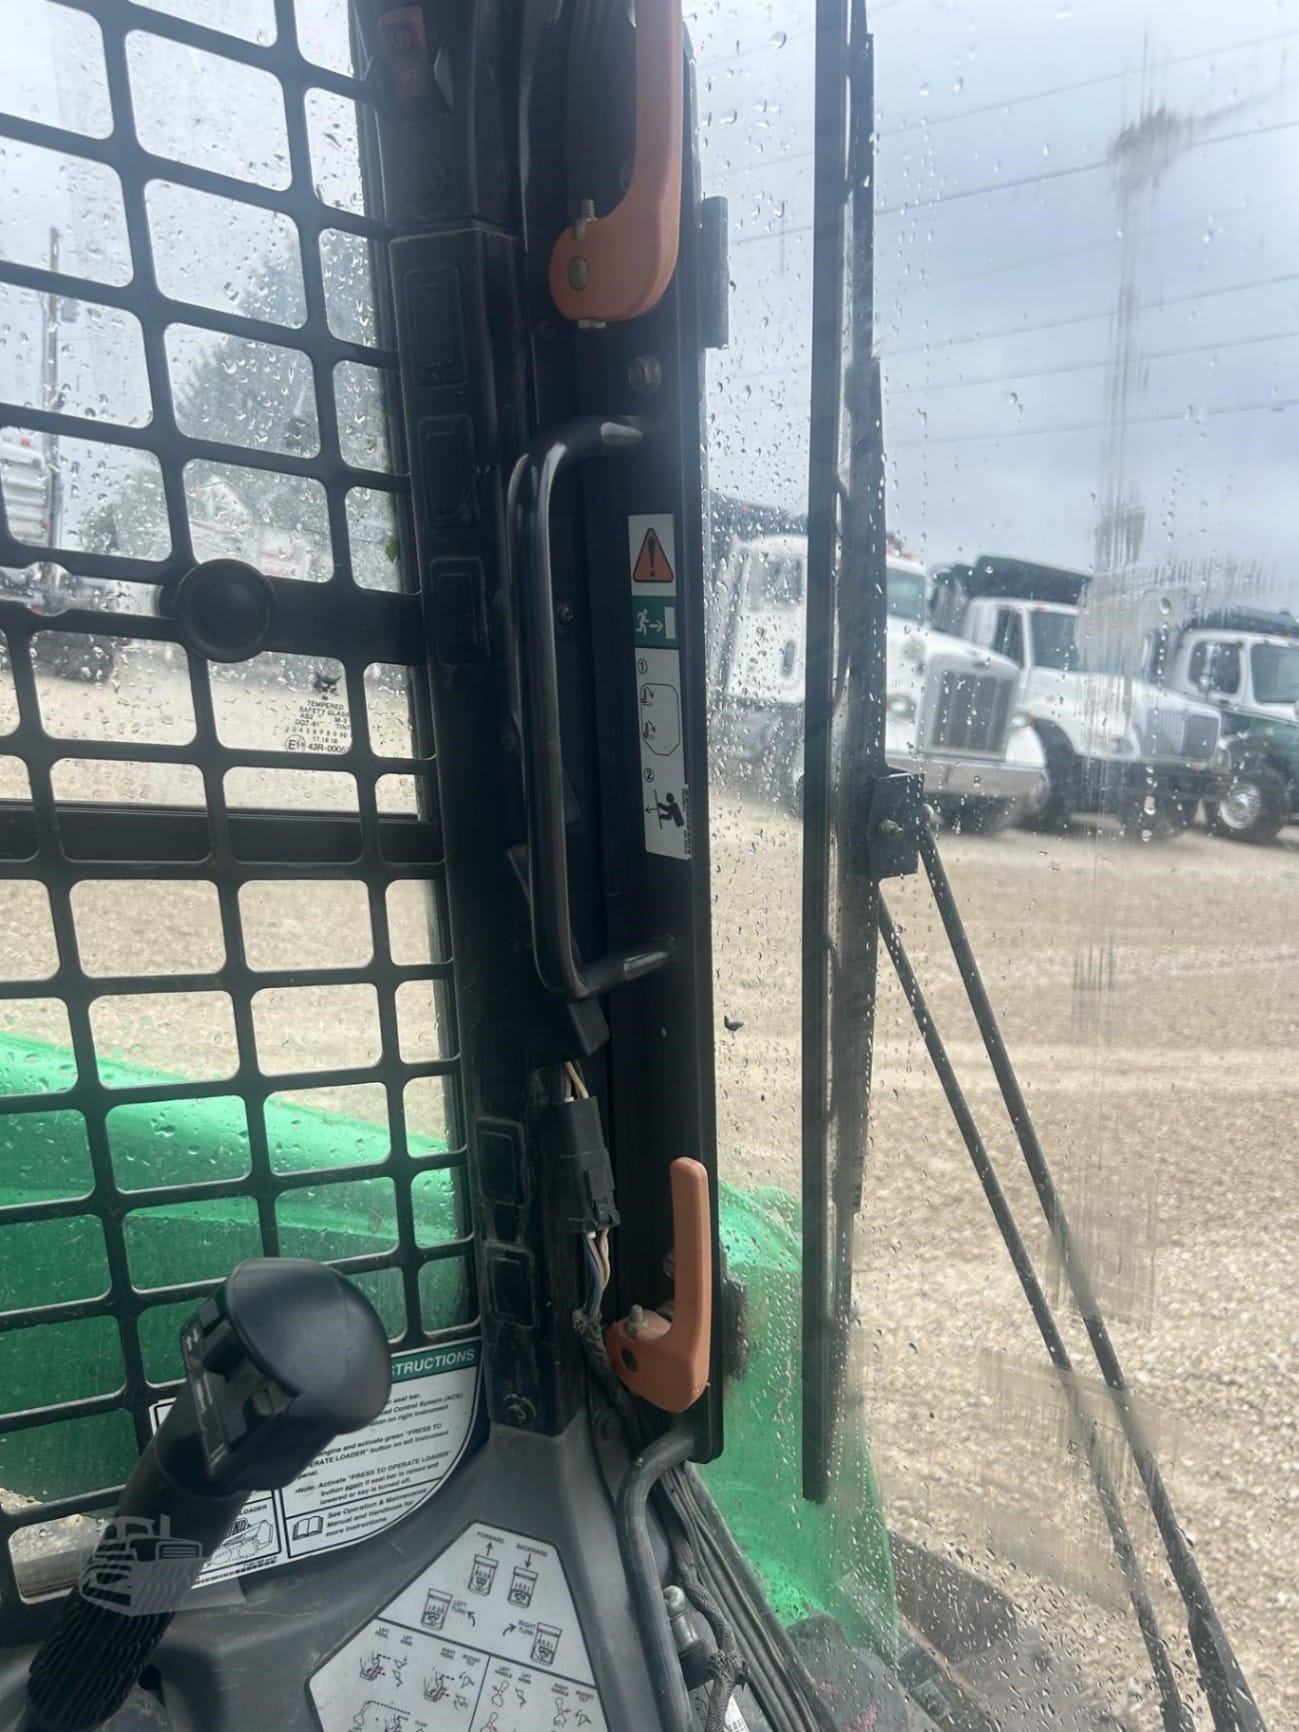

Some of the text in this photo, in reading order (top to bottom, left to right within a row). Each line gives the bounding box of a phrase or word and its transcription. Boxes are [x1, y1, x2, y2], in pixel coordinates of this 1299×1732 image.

[299, 705, 326, 716] SAFETY
[307, 699, 344, 710] TEMPERED
[394, 1402, 418, 1413] Control
[419, 1398, 443, 1408] System
[398, 1411, 414, 1421] right
[414, 1403, 449, 1416] instrument
[343, 1442, 356, 1451] and
[357, 1437, 383, 1448] activate
[385, 1432, 404, 1442] green
[432, 1421, 442, 1431] TO
[370, 1443, 392, 1454] button
[415, 1429, 449, 1443] instrument
[318, 1476, 346, 1489] Activate
[376, 1465, 386, 1475] TO
[387, 1457, 420, 1472] OPERATE
[321, 1486, 344, 1497] button
[406, 1463, 426, 1475] raised
[427, 1460, 439, 1470] and
[319, 1493, 348, 1506] lowered
[357, 1488, 369, 1499] key
[378, 1479, 400, 1491] turned
[327, 1510, 342, 1519] See
[343, 1501, 378, 1515] Operation
[326, 1516, 354, 1528] Manual
[354, 1511, 368, 1521] and
[326, 1527, 345, 1538] more
[476, 1531, 505, 1545] FORWARD
[516, 1542, 548, 1558] BACKWARD
